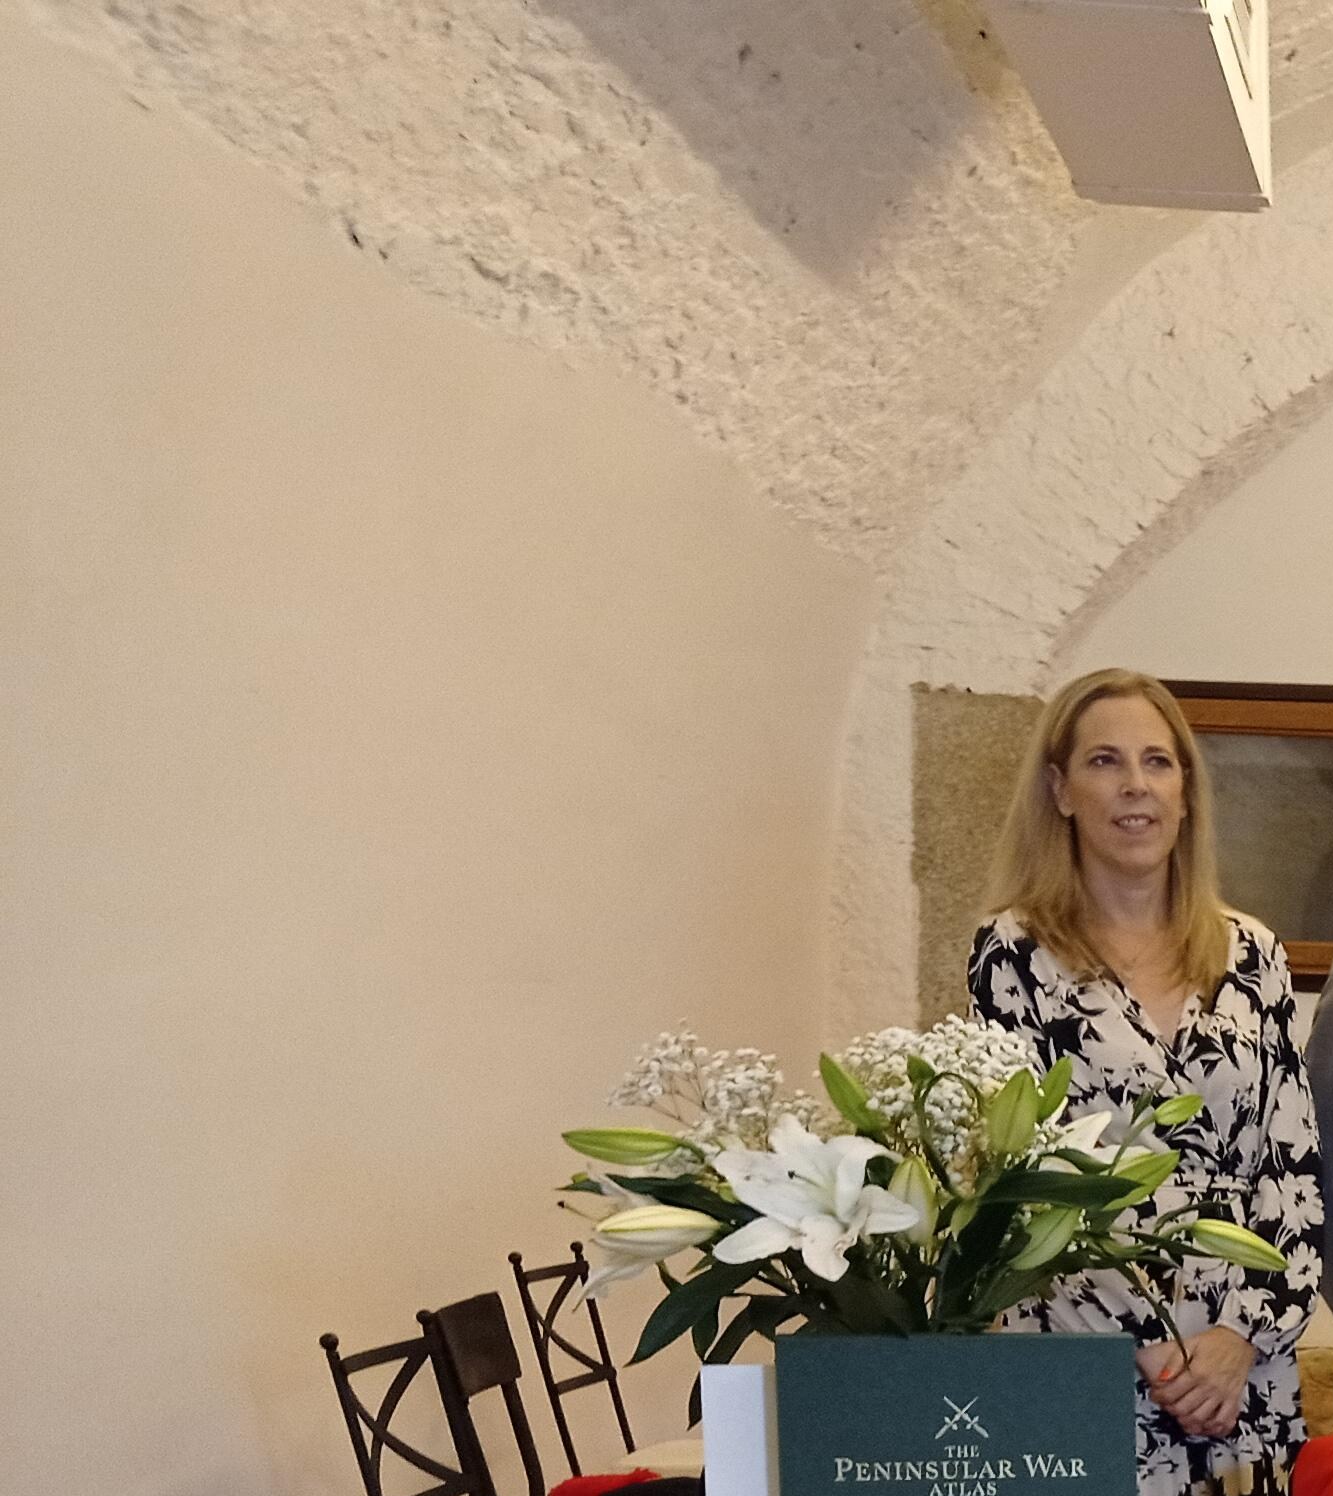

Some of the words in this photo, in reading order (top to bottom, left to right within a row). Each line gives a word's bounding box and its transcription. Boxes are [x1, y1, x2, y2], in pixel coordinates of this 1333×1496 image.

[944, 1445, 980, 1458] THE
[834, 1457, 1016, 1482] PENINSULAR
[1022, 1454, 1088, 1478] WAR
